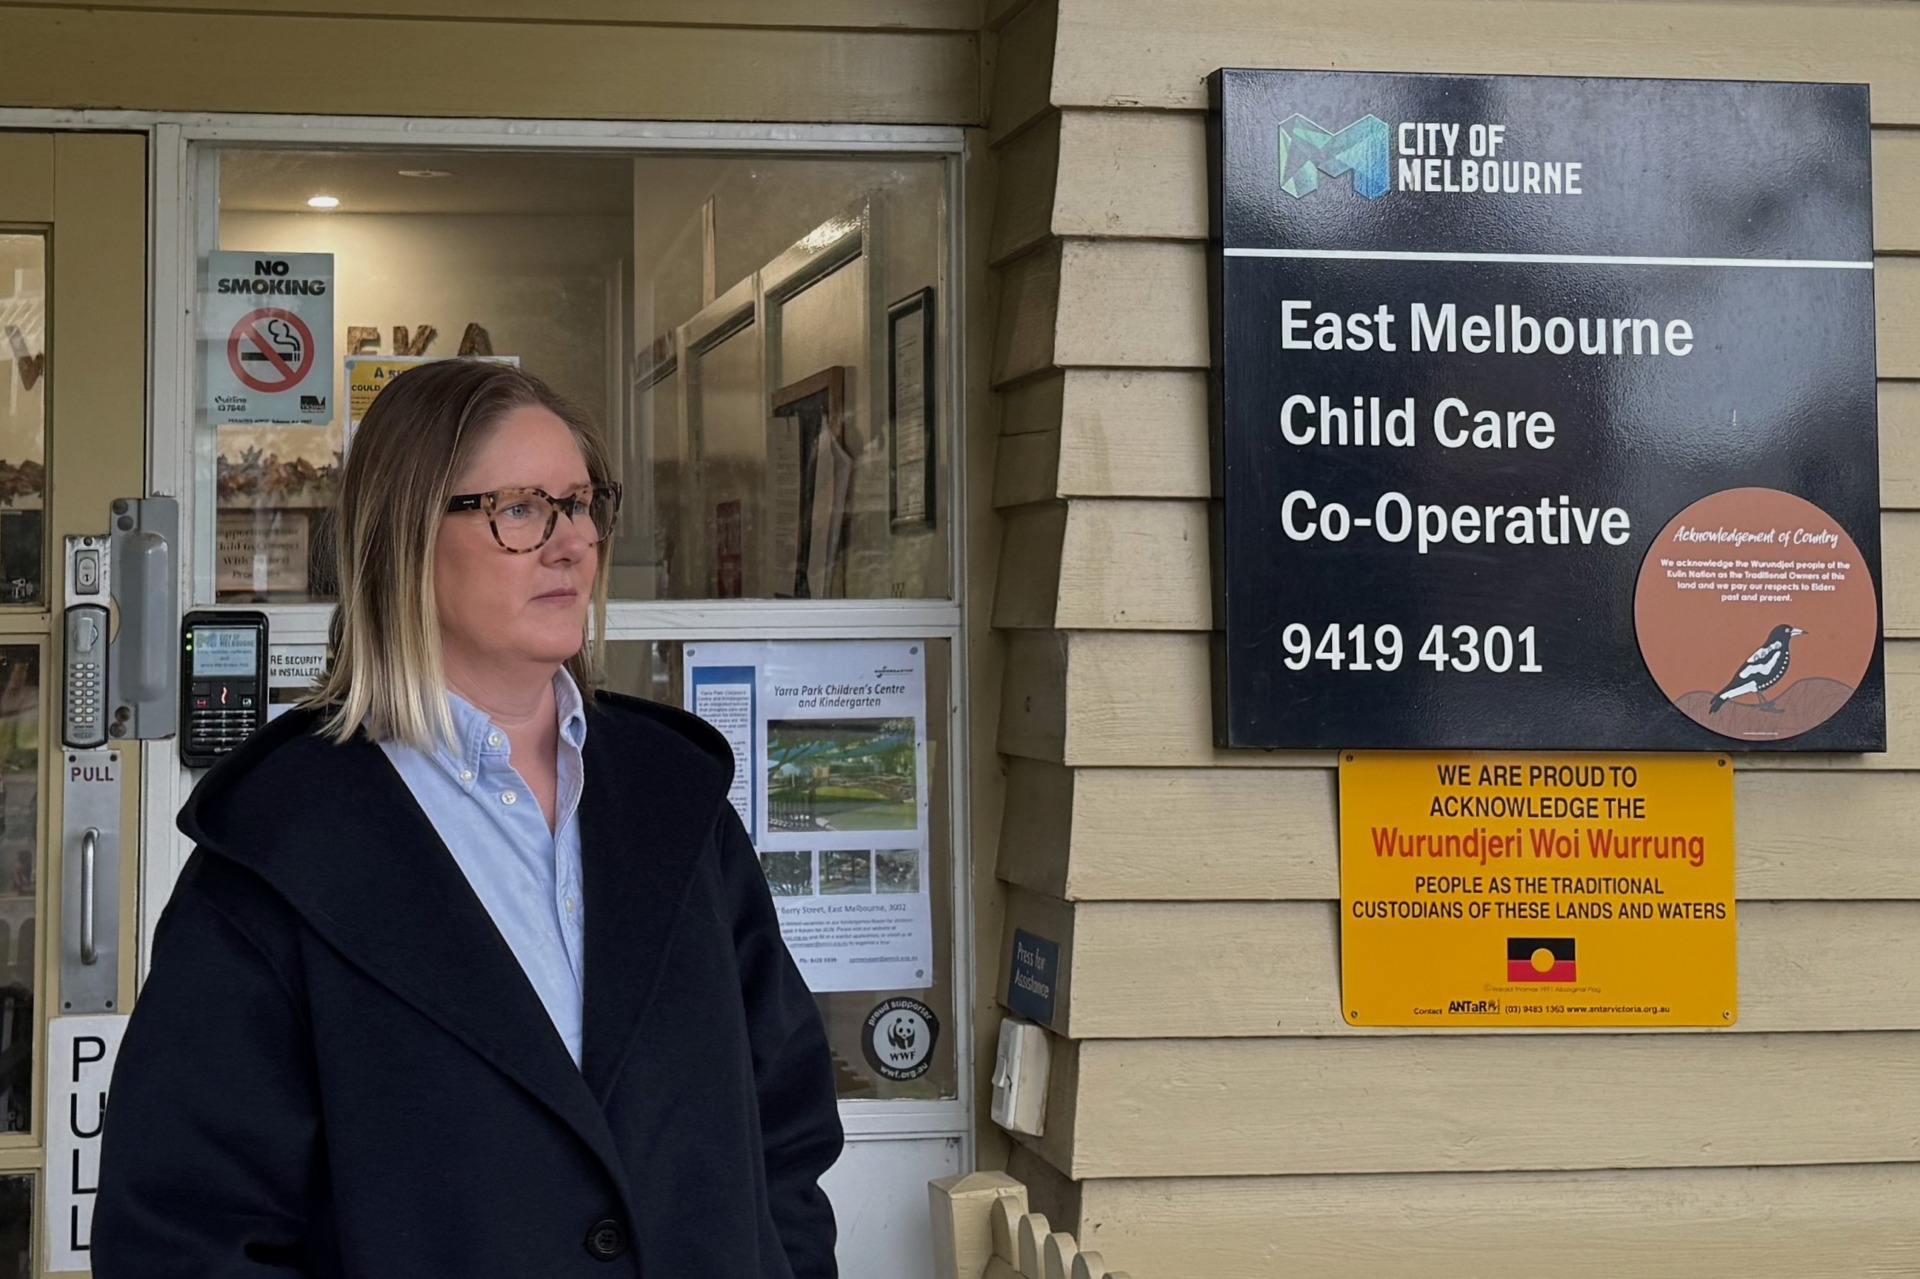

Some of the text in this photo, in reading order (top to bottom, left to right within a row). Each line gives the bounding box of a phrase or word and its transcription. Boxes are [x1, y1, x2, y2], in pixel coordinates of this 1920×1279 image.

[1398, 122, 1506, 157] CITY OF
[1398, 158, 1582, 195] MELBOURNE
[254, 260, 290, 276] NO
[217, 278, 326, 296] SMOKING
[1281, 300, 1694, 357] East Melbourne
[351, 384, 381, 392] COULD
[1280, 394, 1556, 450] Child Care
[1281, 490, 1631, 554] Co-Operative
[1672, 525, 1839, 549] Acknowledgement of Country
[1660, 559, 1674, 567] We
[1676, 559, 1734, 569] acknowledge
[1750, 560, 1795, 570] Wurundjeri
[1796, 561, 1826, 570] people
[1827, 561, 1836, 569] of
[1667, 570, 1687, 578] Kulin
[1688, 570, 1716, 578] Nation
[1729, 571, 1743, 579] the
[1744, 571, 1787, 579] Traditional
[1788, 572, 1820, 580] Owners
[1677, 581, 1697, 590] land
[1698, 582, 1715, 590] and
[1730, 583, 1748, 591] pay
[1749, 583, 1763, 591] our
[1764, 583, 1800, 592] respects
[1801, 583, 1810, 591] to
[1811, 583, 1836, 591] Elders
[1721, 594, 1740, 602] past
[1759, 594, 1793, 602] present.
[1282, 623, 1543, 673] 9419 4301
[285, 656, 323, 665] SECURITY
[279, 668, 320, 677] INSTALLED
[774, 683, 906, 696] Yarra Park Children's Centre
[798, 696, 881, 709] and Kindergarten
[71, 767, 114, 782] PULL
[1437, 765, 1637, 788] WE ARE PROUD TO
[1430, 796, 1645, 819] ACKNOWLEDGE THE
[1371, 827, 1704, 867] Wurundjeri Woi Wurrung
[1415, 877, 1664, 895] PEOPLE AS THE TRADITIONAL
[802, 906, 826, 914] Street,
[828, 905, 843, 913] East
[844, 904, 887, 912] Melbourne,
[1352, 901, 1726, 919] CUSTODIANS OF THESE LANDS AND WATERS
[1017, 942, 1045, 971] Press for
[1014, 969, 1050, 999] Assistance
[868, 1000, 932, 1026] proud supporter
[1449, 1001, 1487, 1013] ANTaR
[1566, 1006, 1670, 1014] www.antarvictoria.org.au
[890, 1051, 915, 1061] WWF
[880, 1062, 928, 1079] wwf.org.au
